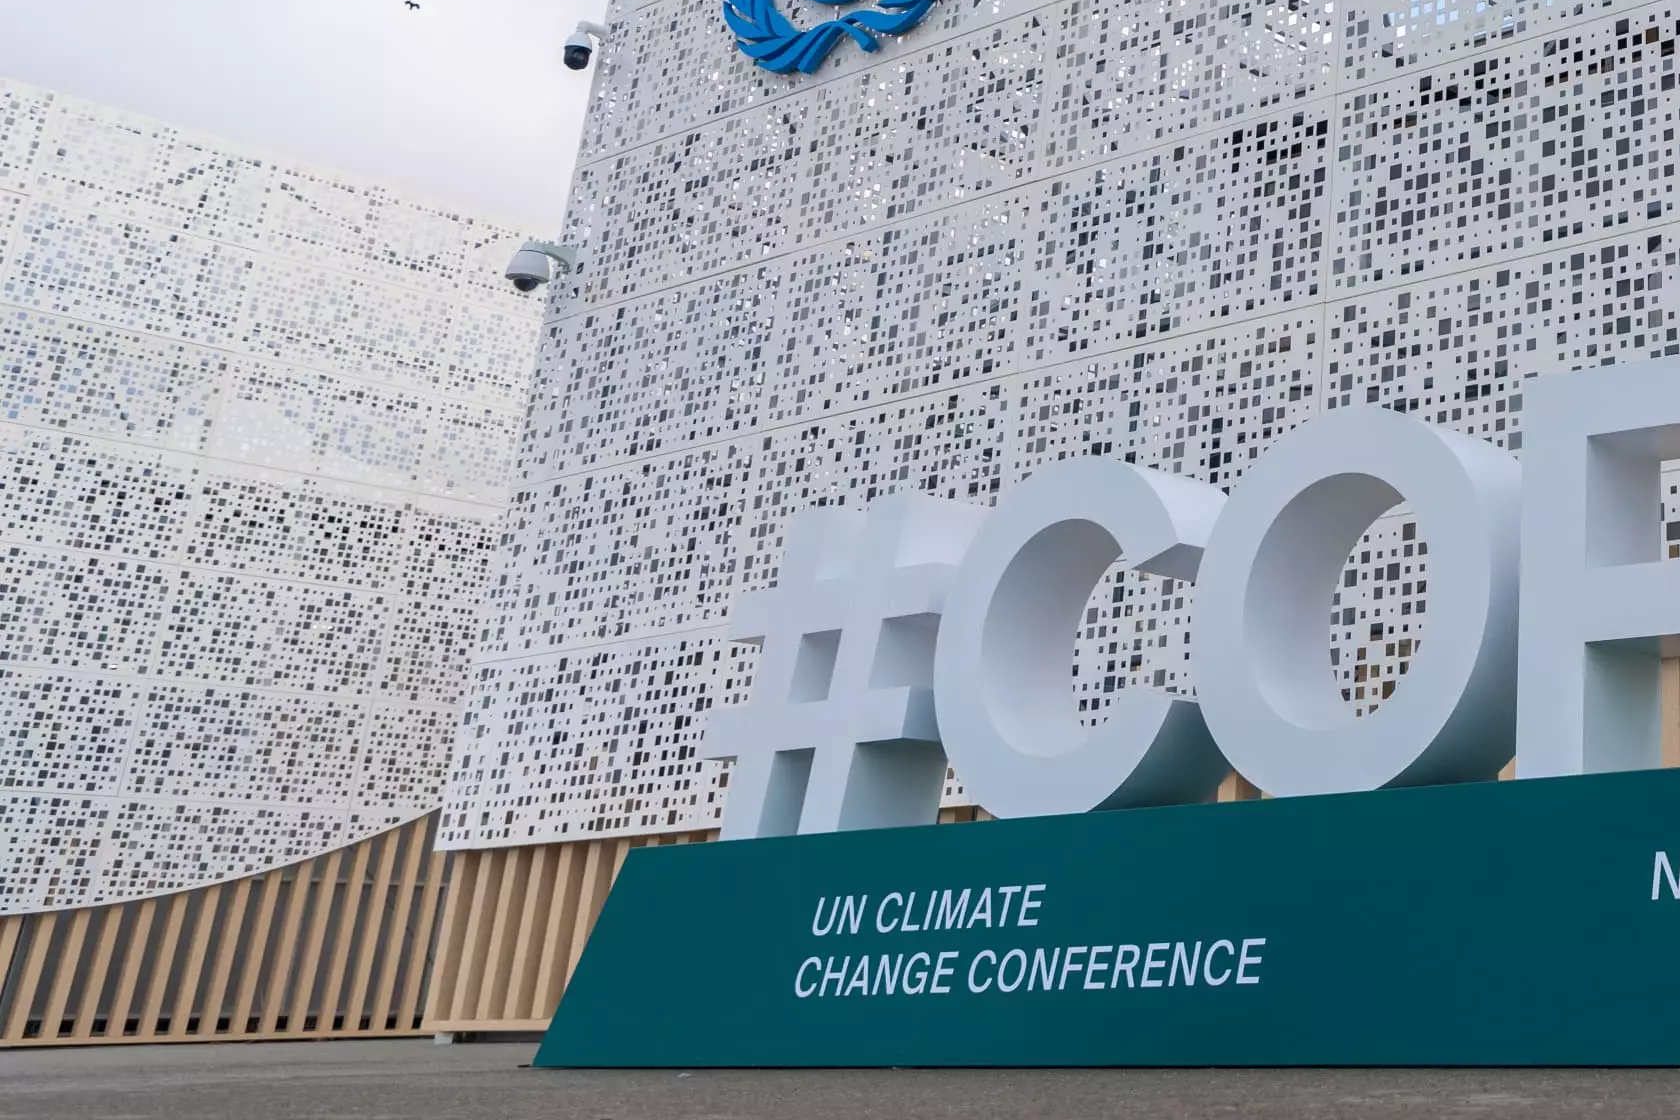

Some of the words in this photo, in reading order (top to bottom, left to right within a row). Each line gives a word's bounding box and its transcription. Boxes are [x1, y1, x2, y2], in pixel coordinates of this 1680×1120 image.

[811, 894, 868, 936] UN
[875, 883, 1047, 933] CLIMATE
[794, 950, 960, 998] CHANGE
[968, 937, 1266, 993] CONFERENCE
